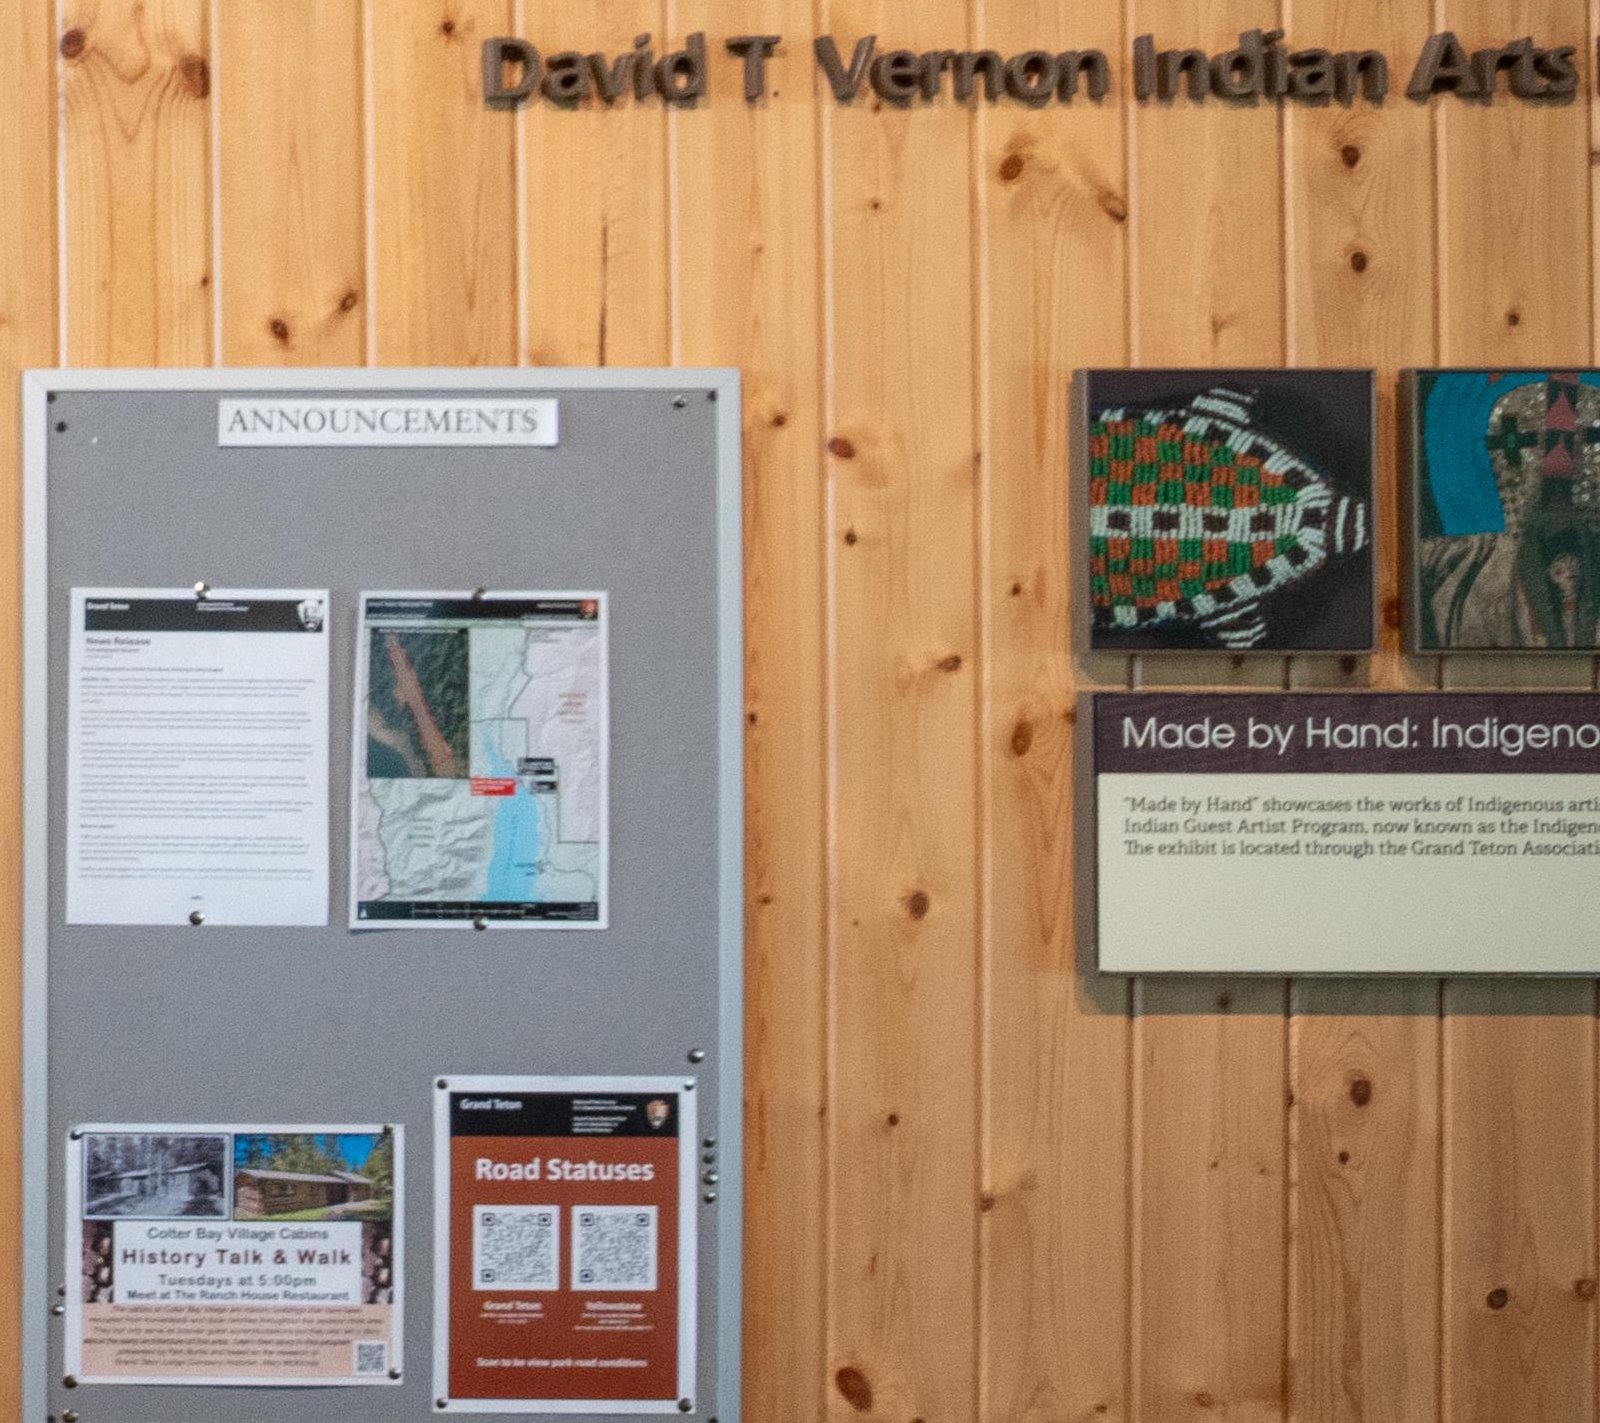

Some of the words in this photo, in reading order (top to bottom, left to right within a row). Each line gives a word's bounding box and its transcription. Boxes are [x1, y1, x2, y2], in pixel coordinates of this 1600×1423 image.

[480, 31, 709, 112] David
[813, 34, 1111, 108] Vernon
[1132, 28, 1390, 108] Indian
[1405, 31, 1578, 106] Arts
[227, 406, 539, 435] ANNOUNCEMENTS
[1123, 716, 1237, 749] Made
[1248, 716, 1295, 756] by
[1306, 716, 1419, 749] Hand:
[1181, 796, 1202, 815] by
[1262, 796, 1352, 812] showcases
[1356, 796, 1384, 812] the
[1389, 796, 1441, 812] works
[1445, 795, 1464, 812] of
[1468, 796, 1565, 816] Indigenous
[1124, 818, 1179, 834] Indian
[1183, 819, 1232, 834] Guest
[1237, 818, 1286, 834] Artist
[1372, 821, 1409, 834] now
[1412, 818, 1473, 834] known
[1477, 822, 1497, 834] as
[1500, 818, 1529, 834] the
[1124, 839, 1154, 855] The
[1157, 839, 1216, 855] exhibit
[1221, 839, 1235, 855] is
[1239, 839, 1300, 855] located
[1304, 839, 1374, 859] through
[1378, 840, 1407, 856] the
[1410, 840, 1465, 856] Grand
[1469, 840, 1520, 856] Teton
[475, 1157, 540, 1181] Road
[546, 1157, 655, 1182] Statuses
[147, 1227, 190, 1240] Colter
[196, 1227, 224, 1242] Bay
[228, 1227, 275, 1242] Village
[279, 1227, 329, 1240] Cabins
[122, 1249, 206, 1268] History
[216, 1248, 263, 1265] Talk
[273, 1249, 288, 1265] &
[298, 1248, 352, 1265] Walk
[157, 1273, 233, 1287] Tuesdays
[237, 1274, 254, 1286] at
